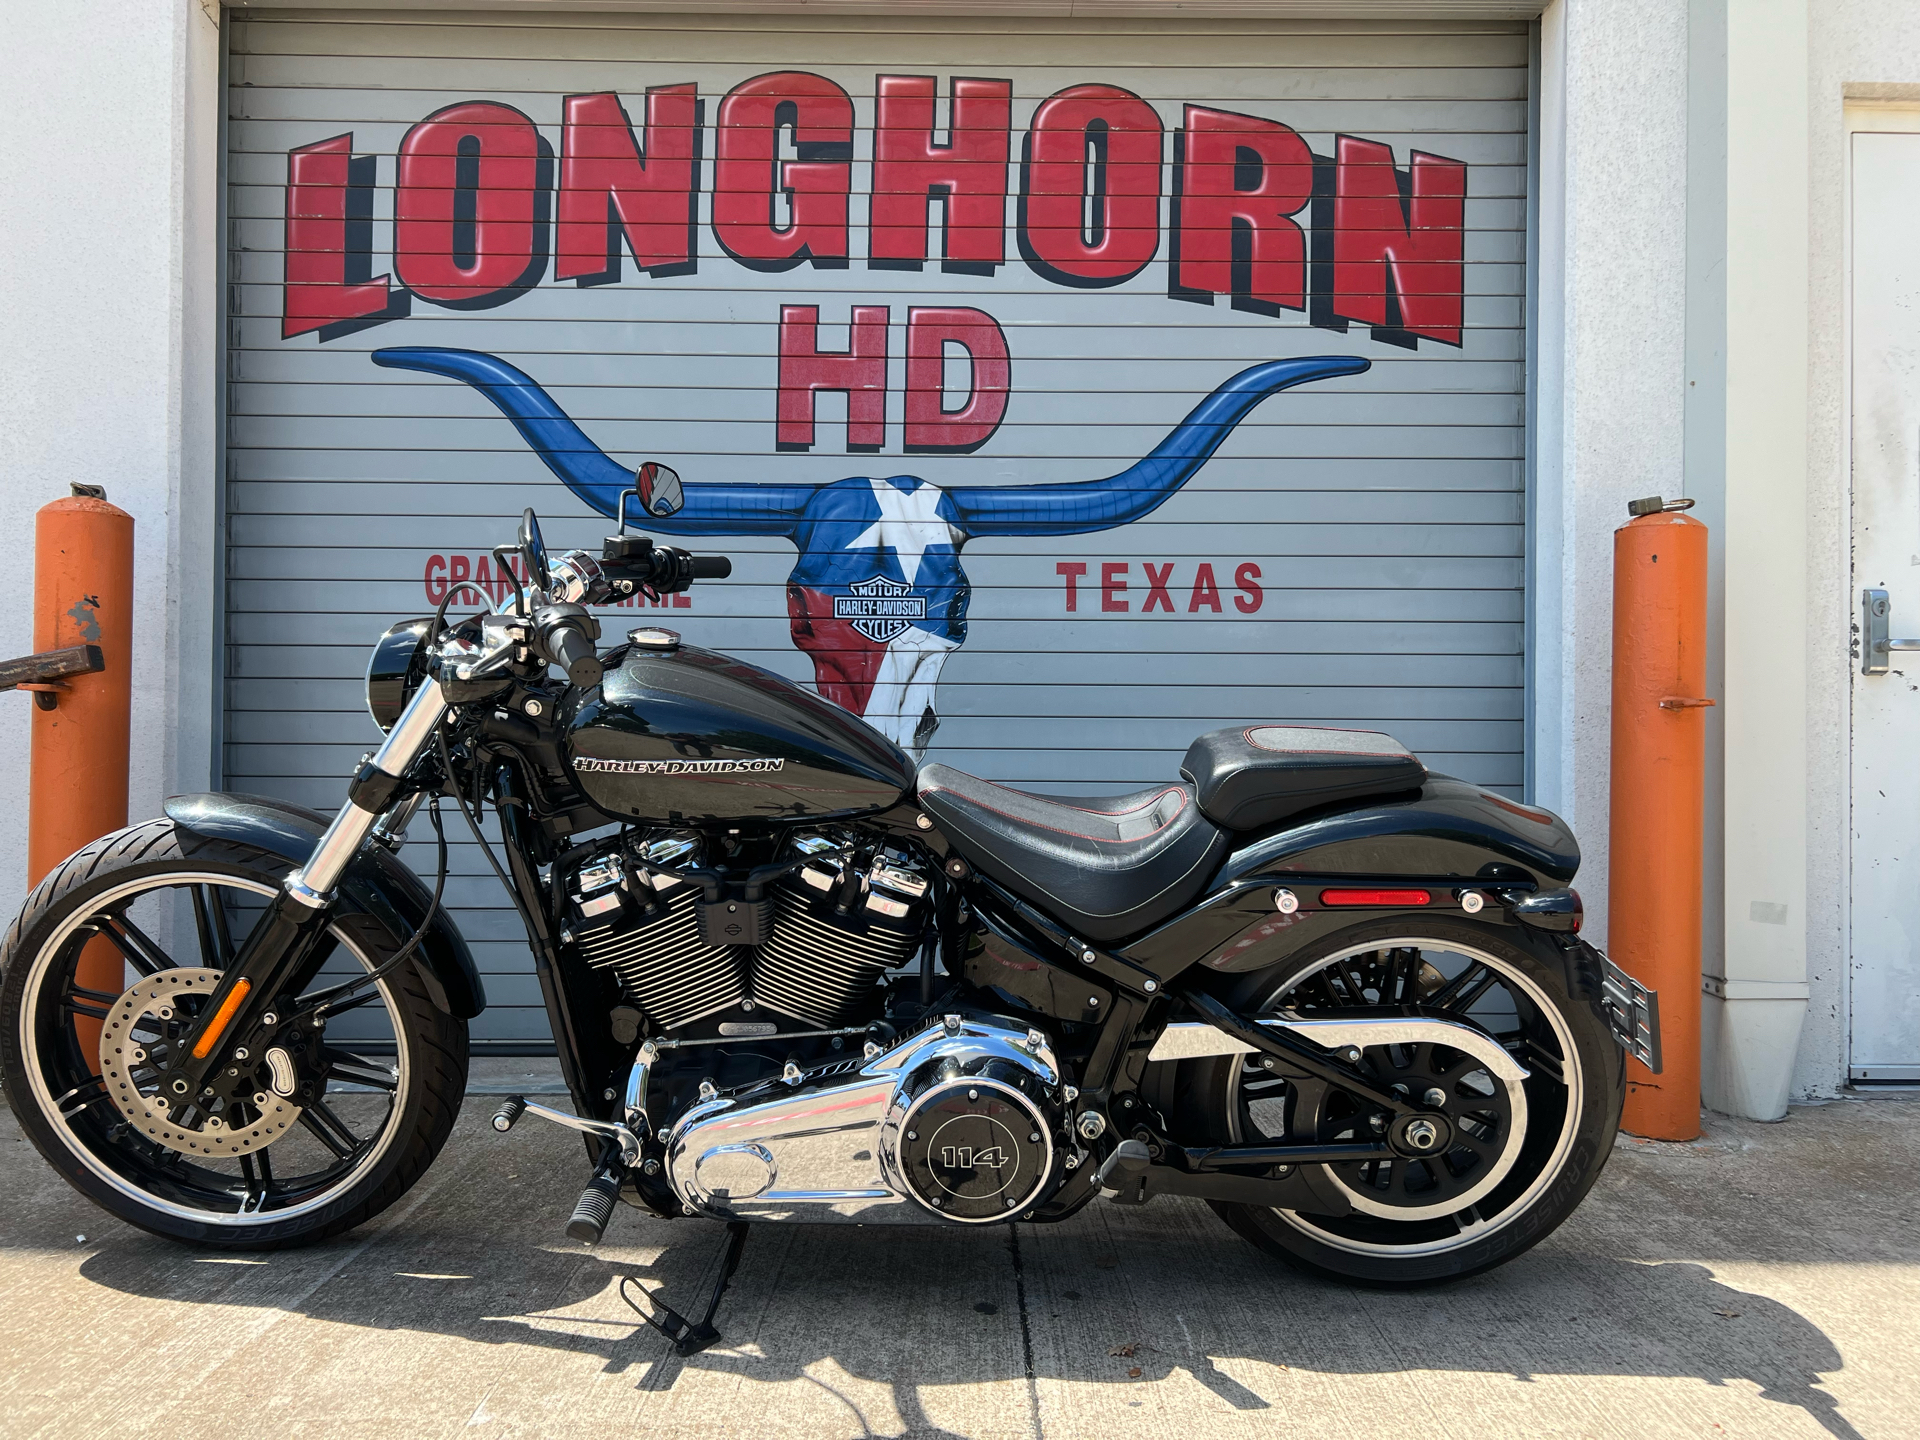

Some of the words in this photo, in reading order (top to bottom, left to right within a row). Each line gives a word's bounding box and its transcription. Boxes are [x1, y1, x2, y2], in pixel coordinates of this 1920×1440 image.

[281, 70, 1468, 351] LONGHORN
[776, 304, 1012, 454] HD
[858, 580, 902, 596] MOTOR
[1056, 562, 1263, 613] TEXAS
[839, 600, 921, 616] HARLEY-DAVIDSON
[858, 619, 903, 639] CYCLES
[572, 756, 785, 774] HARLEY-DAVIDSON
[941, 1146, 1010, 1168] 114
